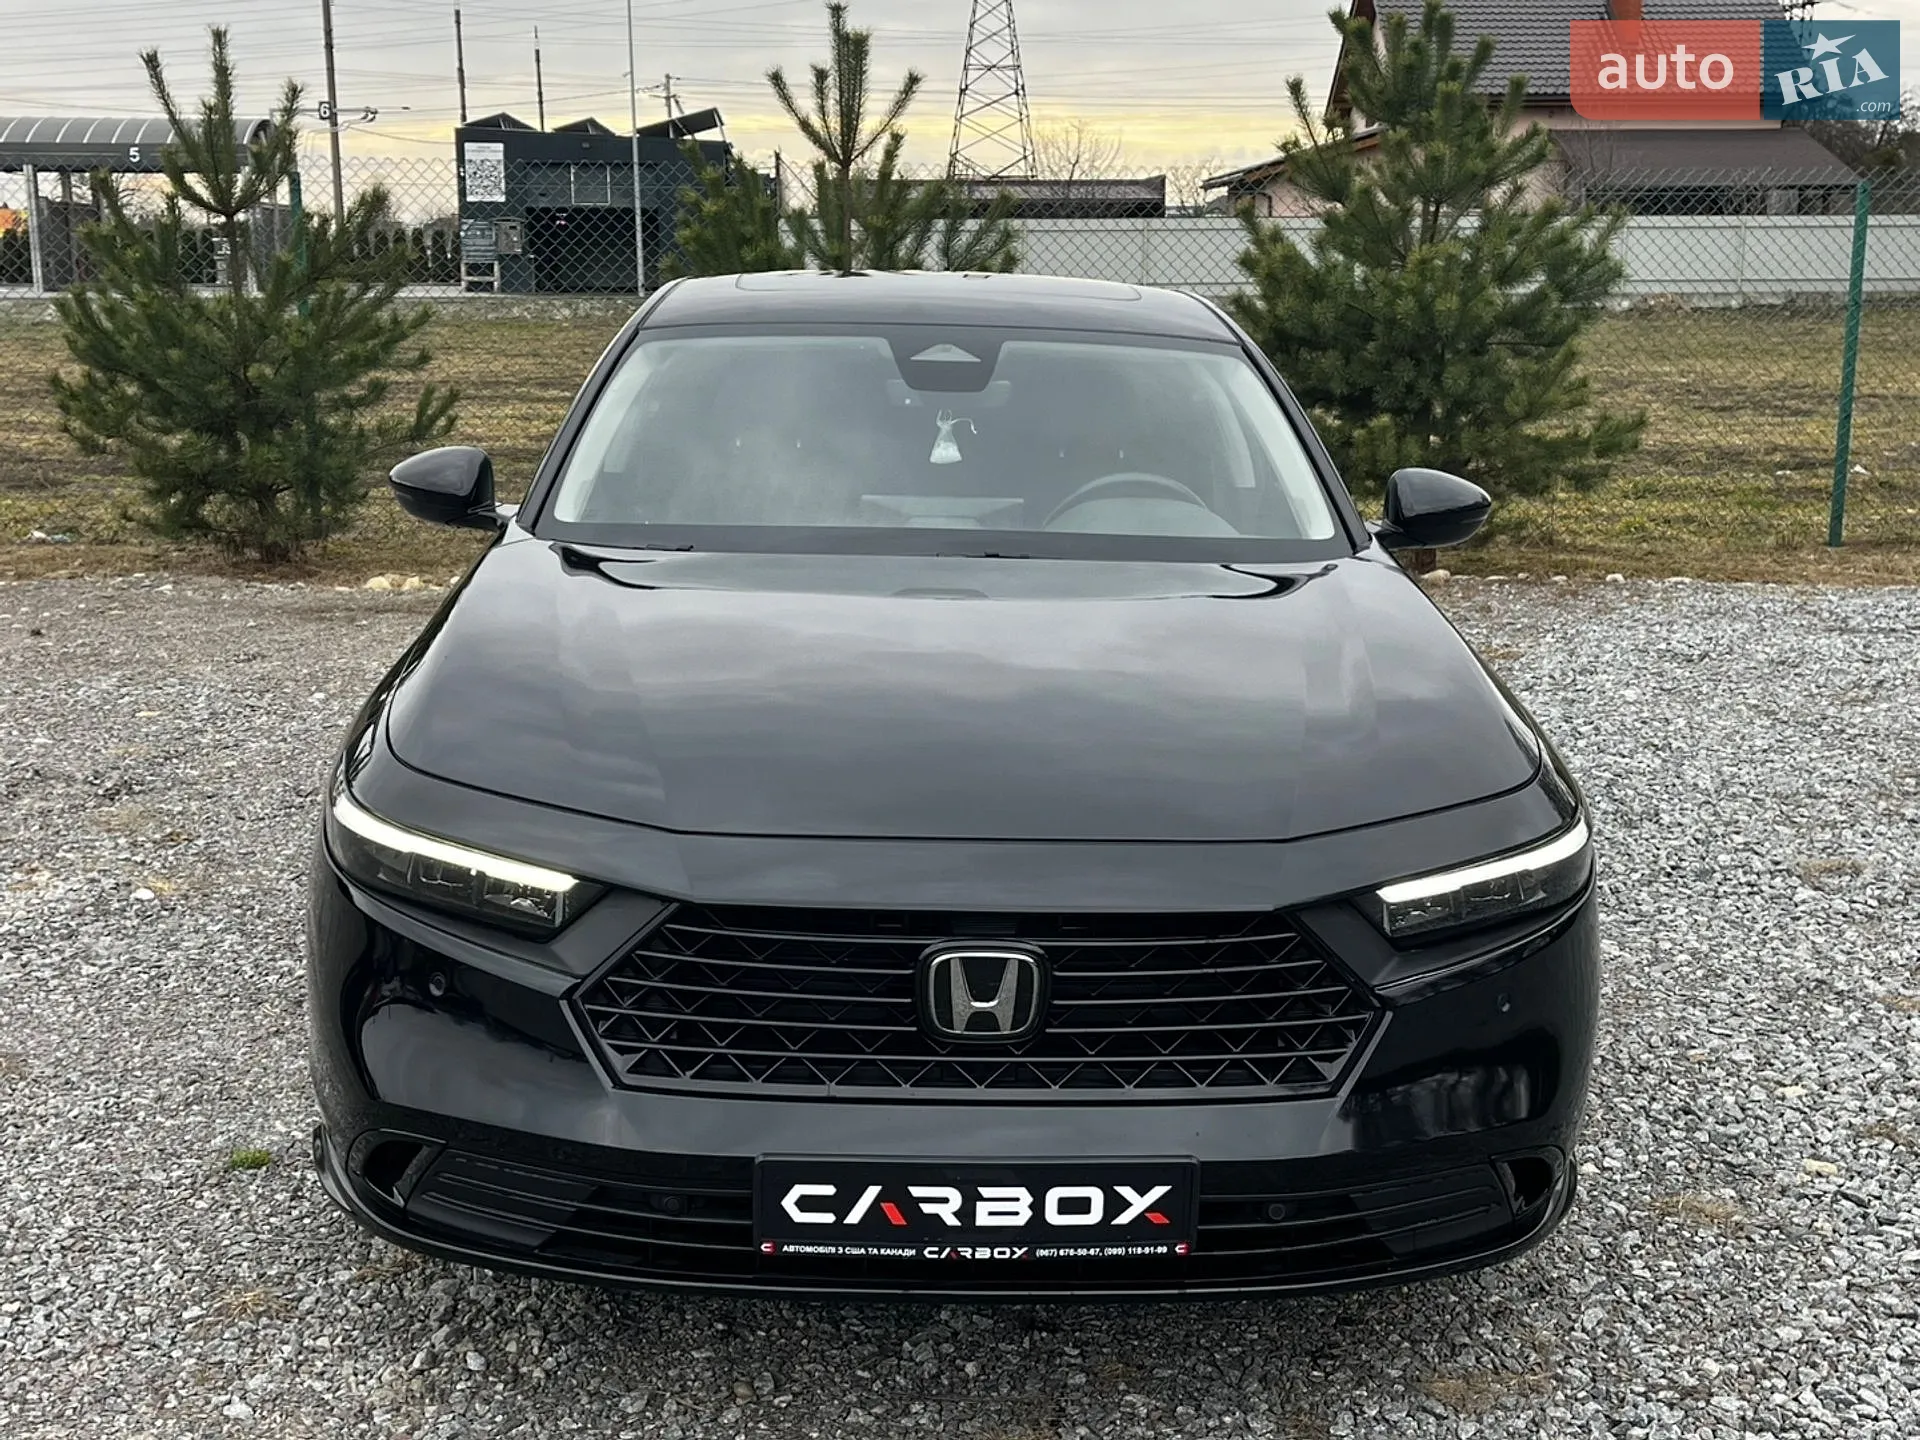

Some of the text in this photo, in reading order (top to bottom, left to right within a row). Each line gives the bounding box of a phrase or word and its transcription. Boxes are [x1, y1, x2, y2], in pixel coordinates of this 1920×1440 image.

[320, 103, 330, 118] 6
[129, 147, 140, 162] 5
[780, 1183, 1173, 1227] CARBOX
[844, 1246, 867, 1255] США
[867, 1247, 879, 1255] ТА
[880, 1247, 916, 1257] КАНАДИ
[923, 1247, 1029, 1259] CARBOX
